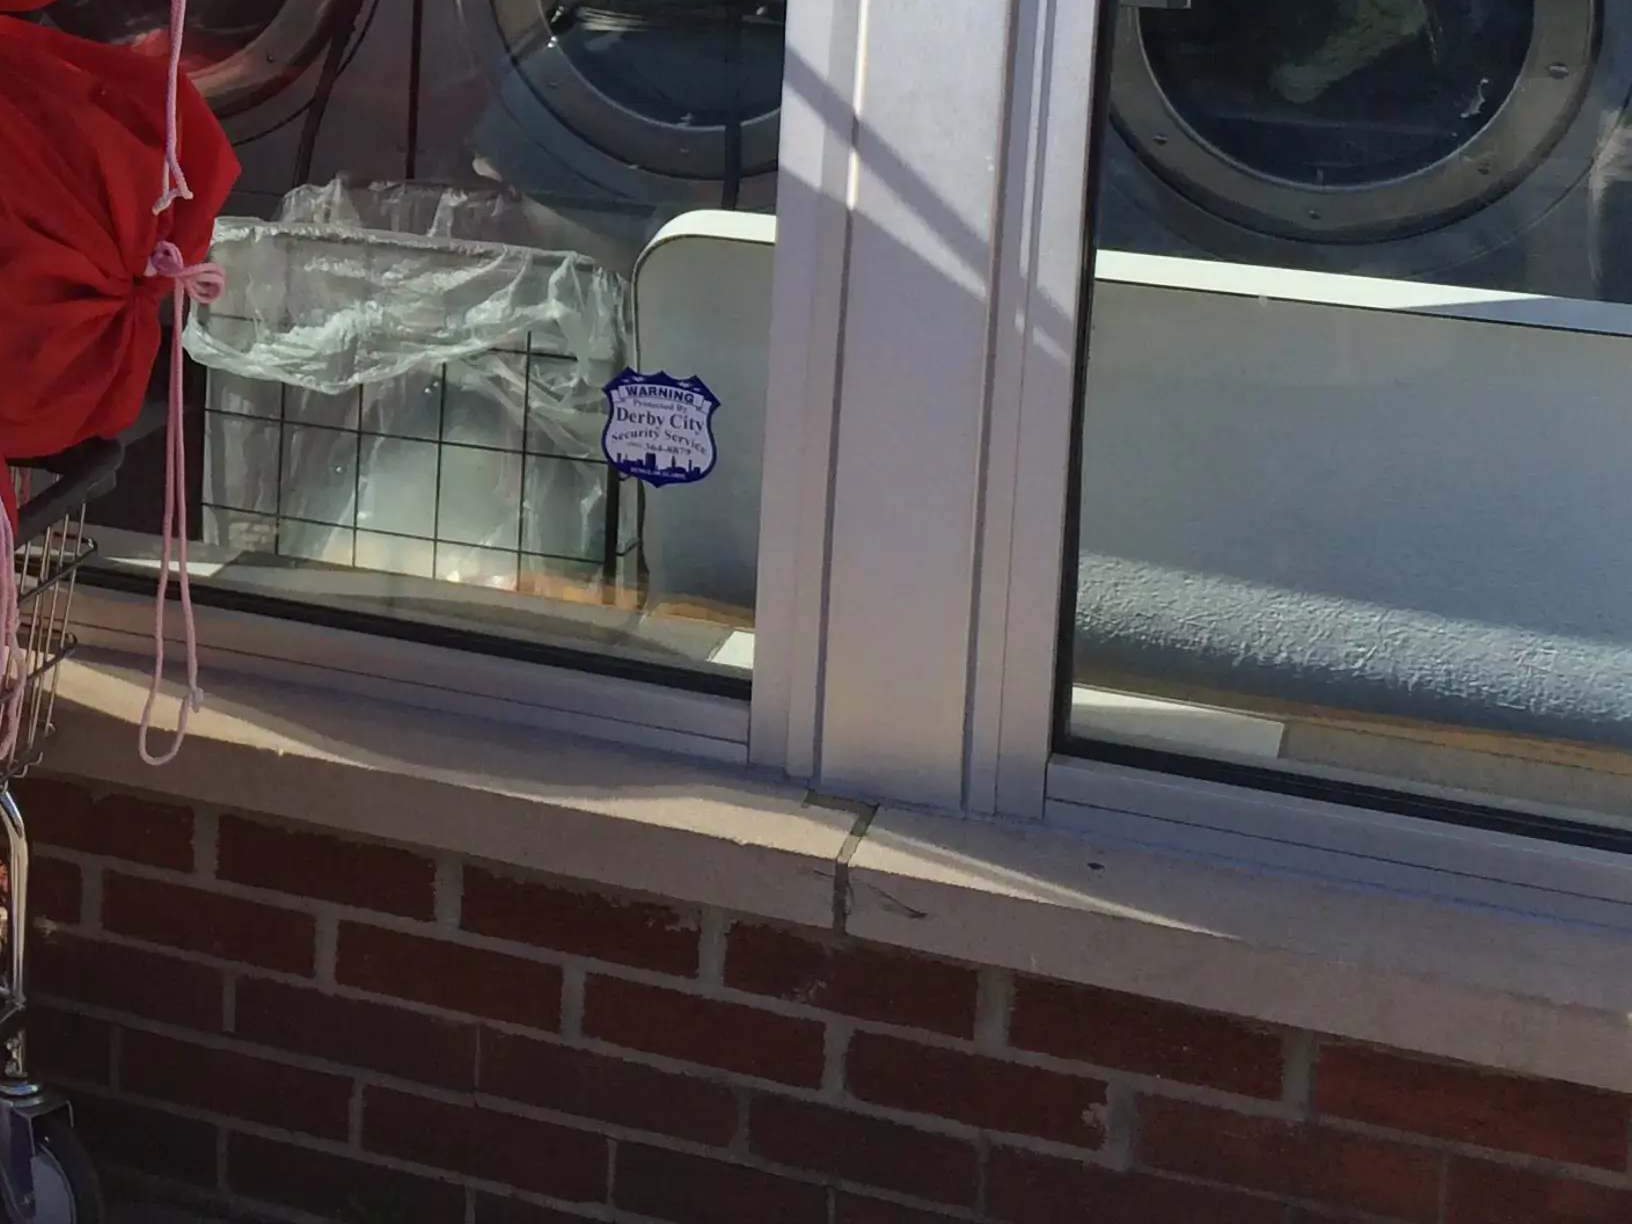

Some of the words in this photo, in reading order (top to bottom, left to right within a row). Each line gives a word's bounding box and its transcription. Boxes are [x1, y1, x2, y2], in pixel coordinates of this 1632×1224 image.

[626, 385, 695, 403] WARNING
[616, 407, 665, 430] Derby
[669, 413, 705, 436] City
[611, 428, 660, 443] Security
[665, 429, 707, 455] Service
